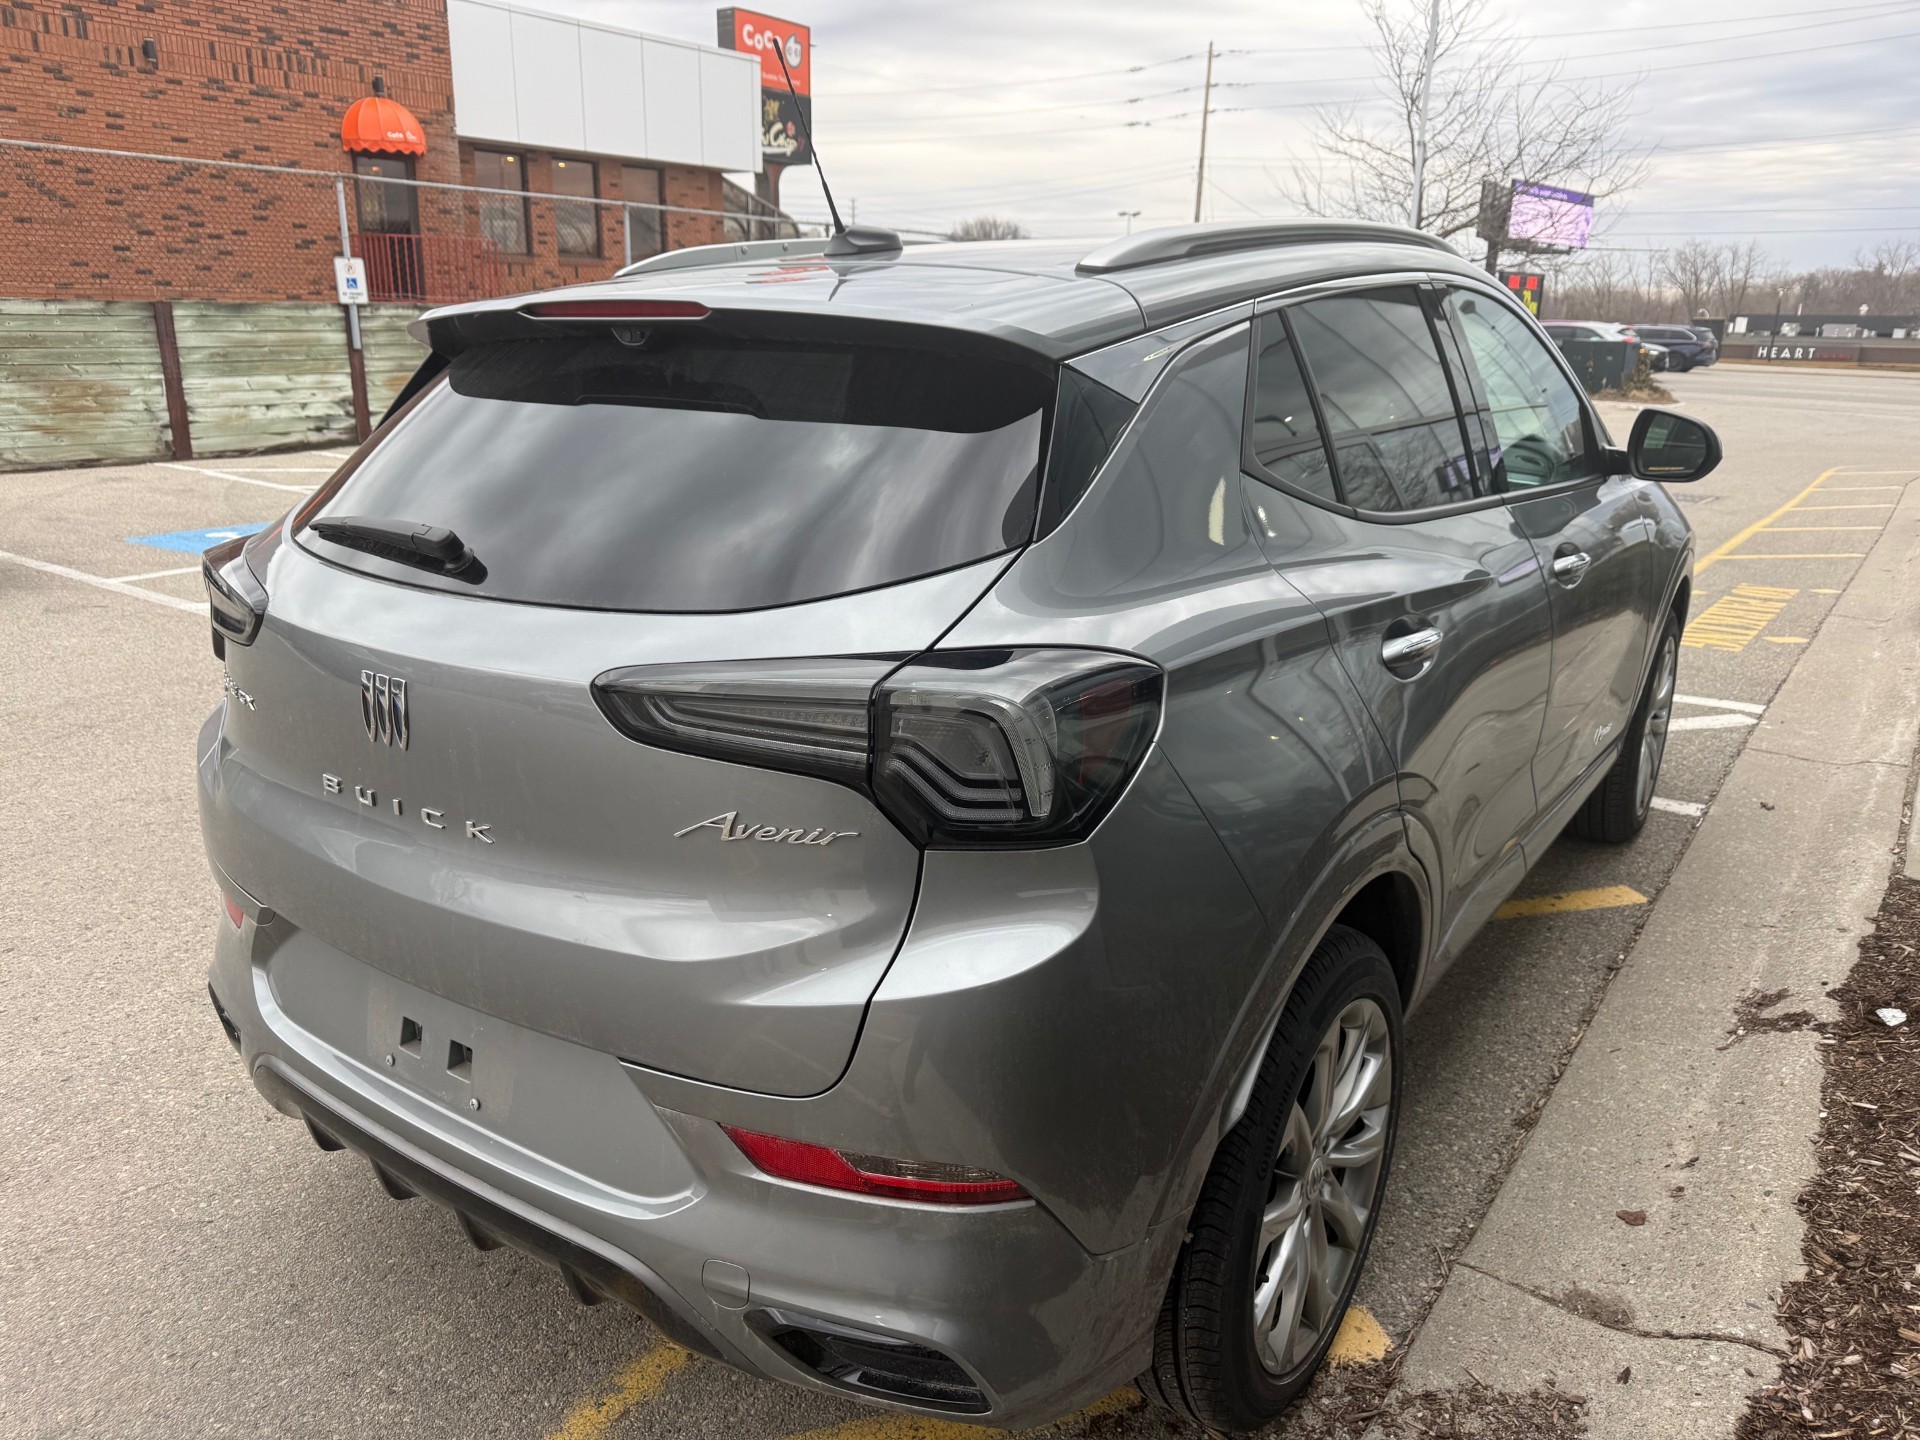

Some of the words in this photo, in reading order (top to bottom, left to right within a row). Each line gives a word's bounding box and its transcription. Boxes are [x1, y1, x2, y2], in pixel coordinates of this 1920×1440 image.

[1757, 345, 1816, 360] HEART
[322, 772, 496, 844] BUICK
[673, 811, 861, 846] Avenir
